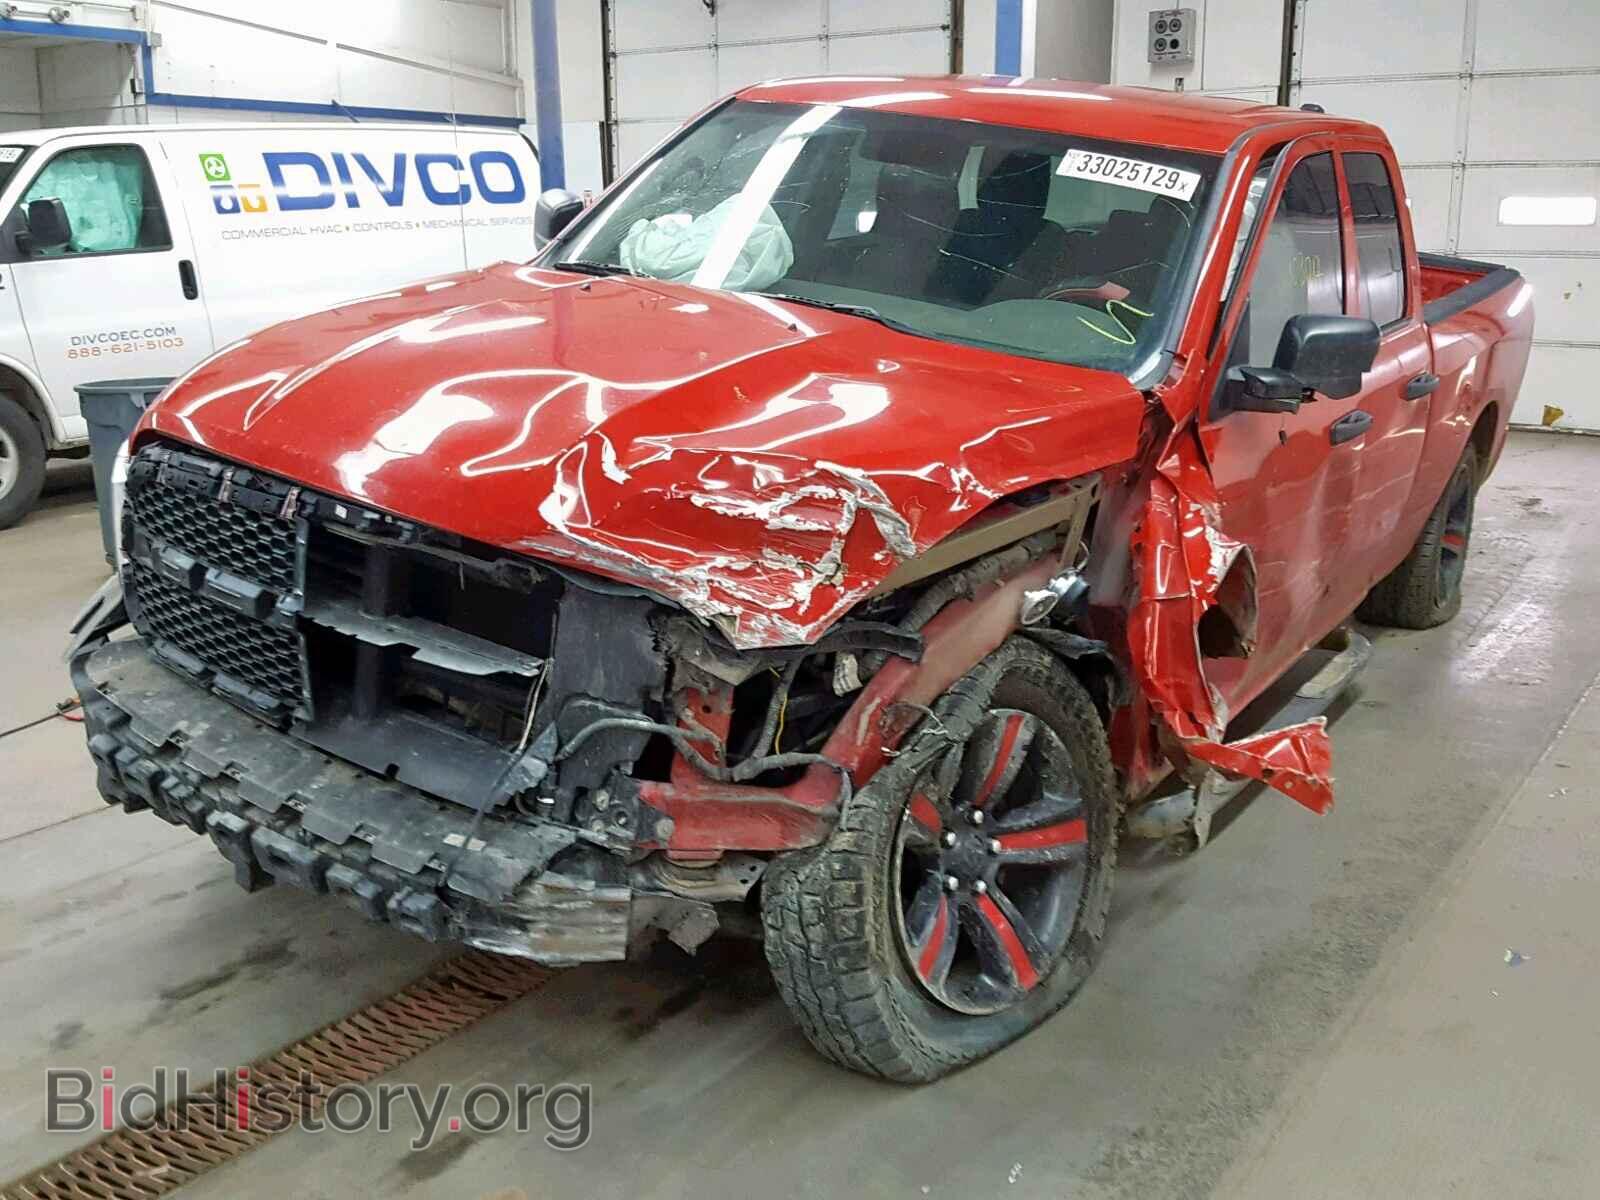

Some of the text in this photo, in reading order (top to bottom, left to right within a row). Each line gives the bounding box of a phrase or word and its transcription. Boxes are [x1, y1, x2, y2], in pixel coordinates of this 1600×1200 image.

[262, 150, 526, 211] DIVCO
[221, 226, 306, 240] COMMERCIAL
[310, 224, 343, 234] HVAC
[353, 219, 413, 232] CONTROLS
[422, 217, 488, 229] MECHANICAL
[71, 326, 177, 346] DIVCOEC.COM
[67, 337, 184, 359] 888-621-5103
